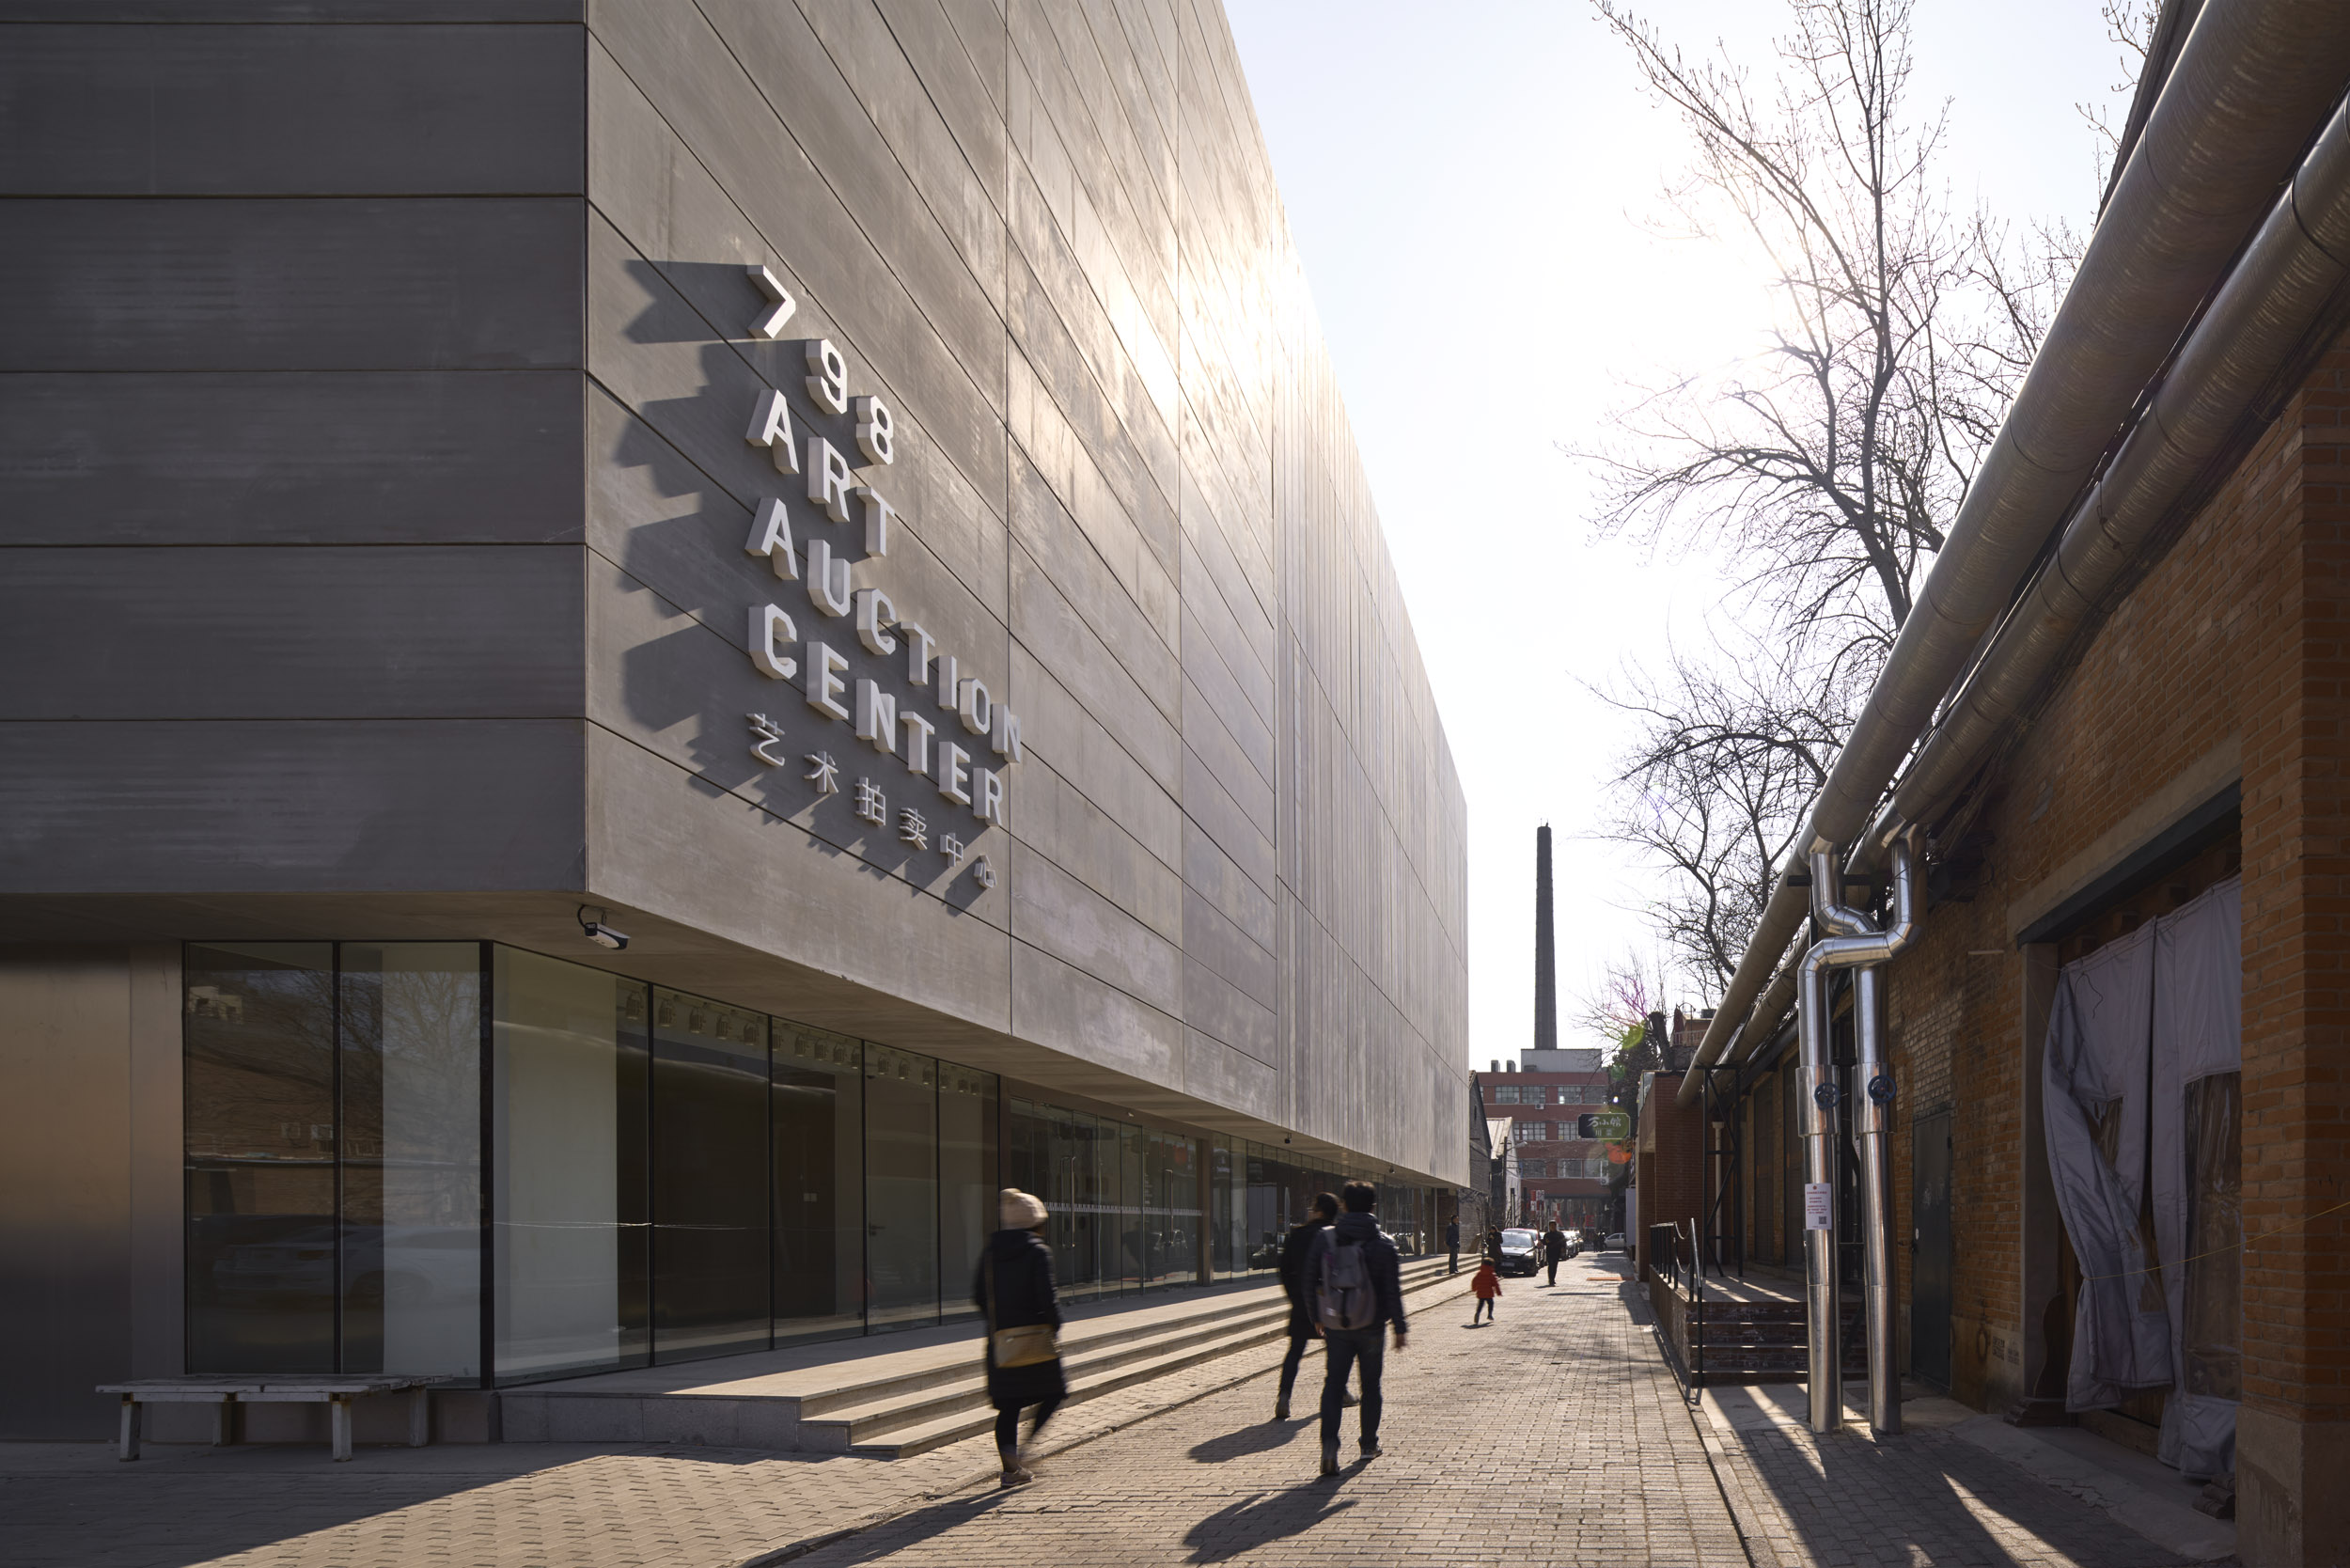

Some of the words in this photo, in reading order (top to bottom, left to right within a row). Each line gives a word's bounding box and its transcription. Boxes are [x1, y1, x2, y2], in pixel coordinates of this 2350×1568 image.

[745, 389, 895, 557] ART
[744, 497, 1021, 764] AUCTION
[748, 603, 1003, 827] CENTER
[745, 713, 997, 888] 艺术拍卖中心
